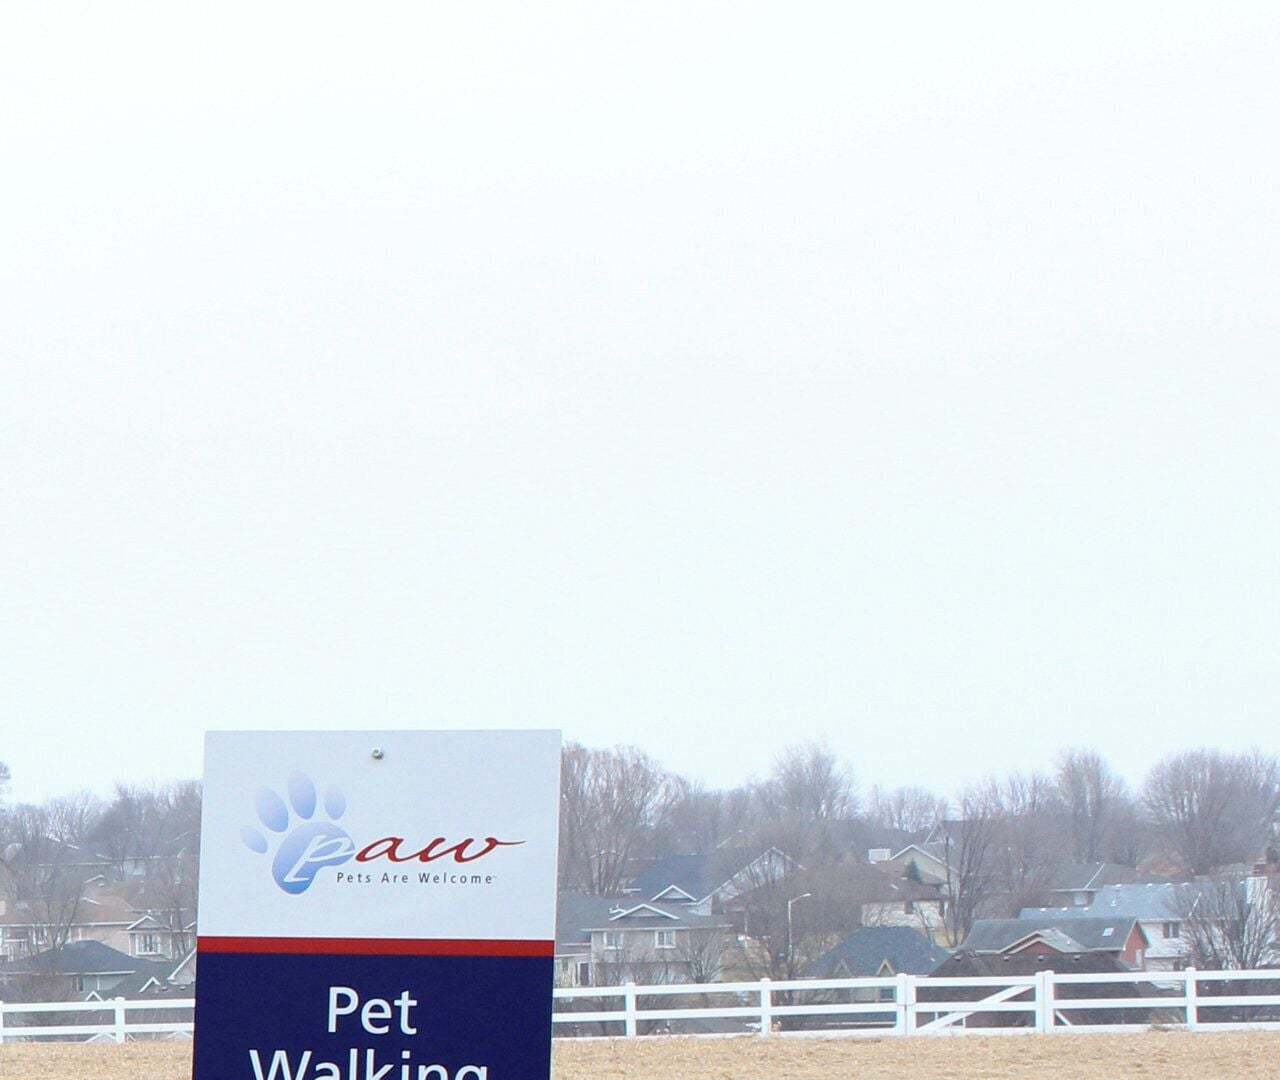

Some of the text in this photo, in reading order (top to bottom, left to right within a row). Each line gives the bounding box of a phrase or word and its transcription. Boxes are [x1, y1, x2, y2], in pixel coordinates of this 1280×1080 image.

[336, 872, 492, 885] Pets Are Welcome
[328, 986, 418, 1035] Pet
